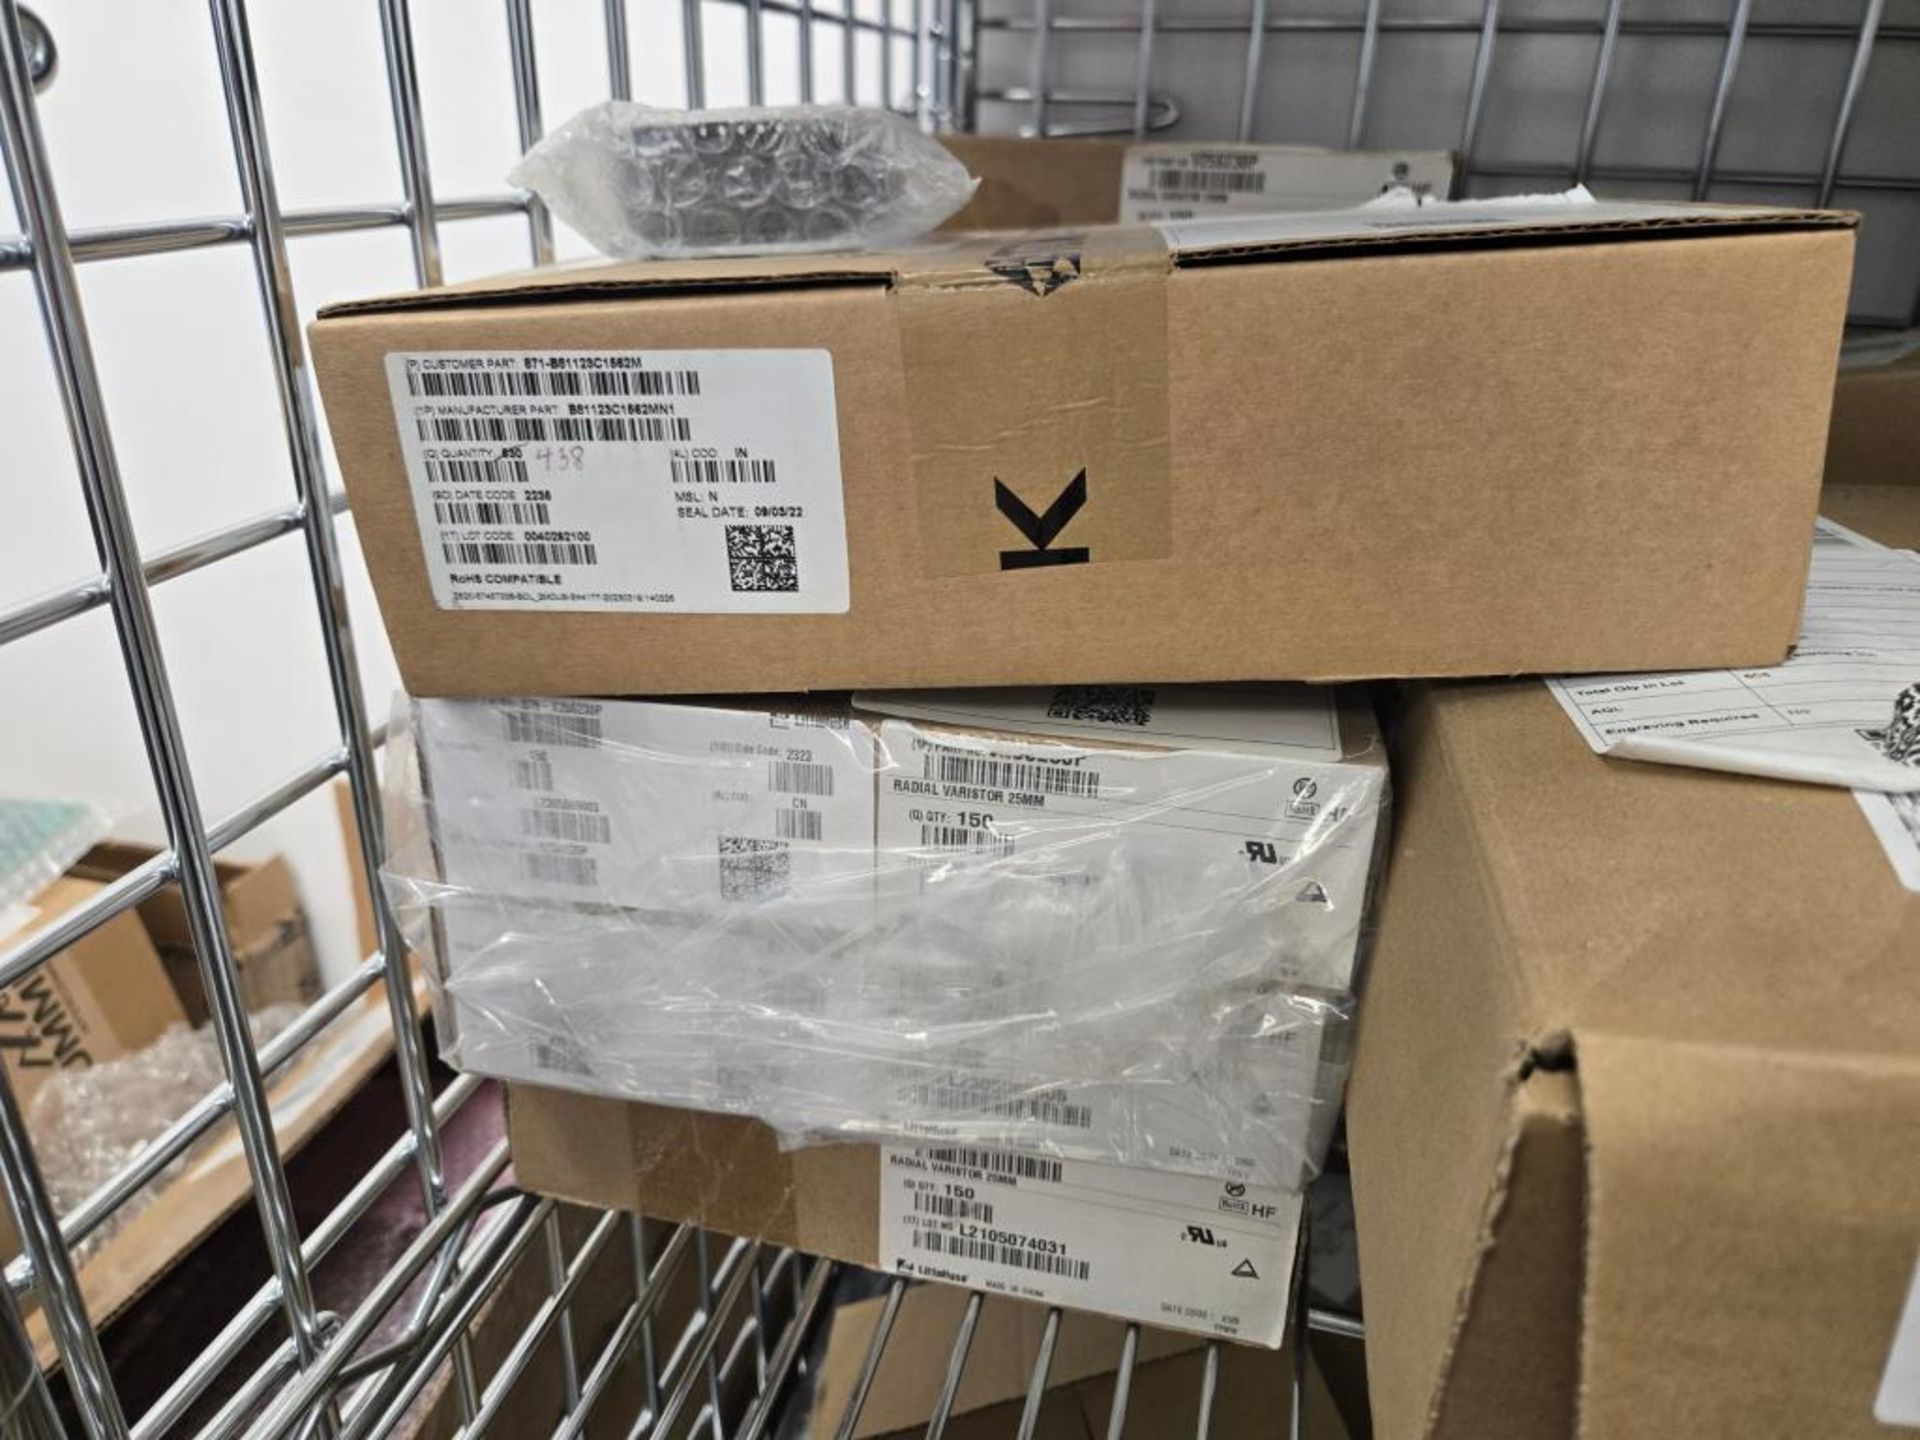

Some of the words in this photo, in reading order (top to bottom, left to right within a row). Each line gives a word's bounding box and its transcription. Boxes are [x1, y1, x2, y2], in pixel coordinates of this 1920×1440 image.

[423, 359, 484, 370] CUSTOMER
[438, 405, 527, 416] MANUFACTURER
[734, 446, 749, 459] IN
[455, 489, 484, 500] DATE
[708, 490, 719, 502] N
[677, 506, 709, 519] SEAL
[485, 573, 562, 586] COMPATIBLE
[1577, 683, 1612, 697] Total
[1604, 718, 1686, 736] Engraving
[1687, 713, 1760, 727] Required
[893, 778, 940, 796] RADIAL
[942, 784, 1004, 804] VARISTOR
[1007, 791, 1046, 808] 25MM
[889, 1154, 928, 1171] RADIAL
[930, 1160, 984, 1181] VARISTOR
[943, 1183, 976, 1200] 150
[1251, 1202, 1277, 1219] HF
[958, 1222, 1068, 1256] L2105074031
